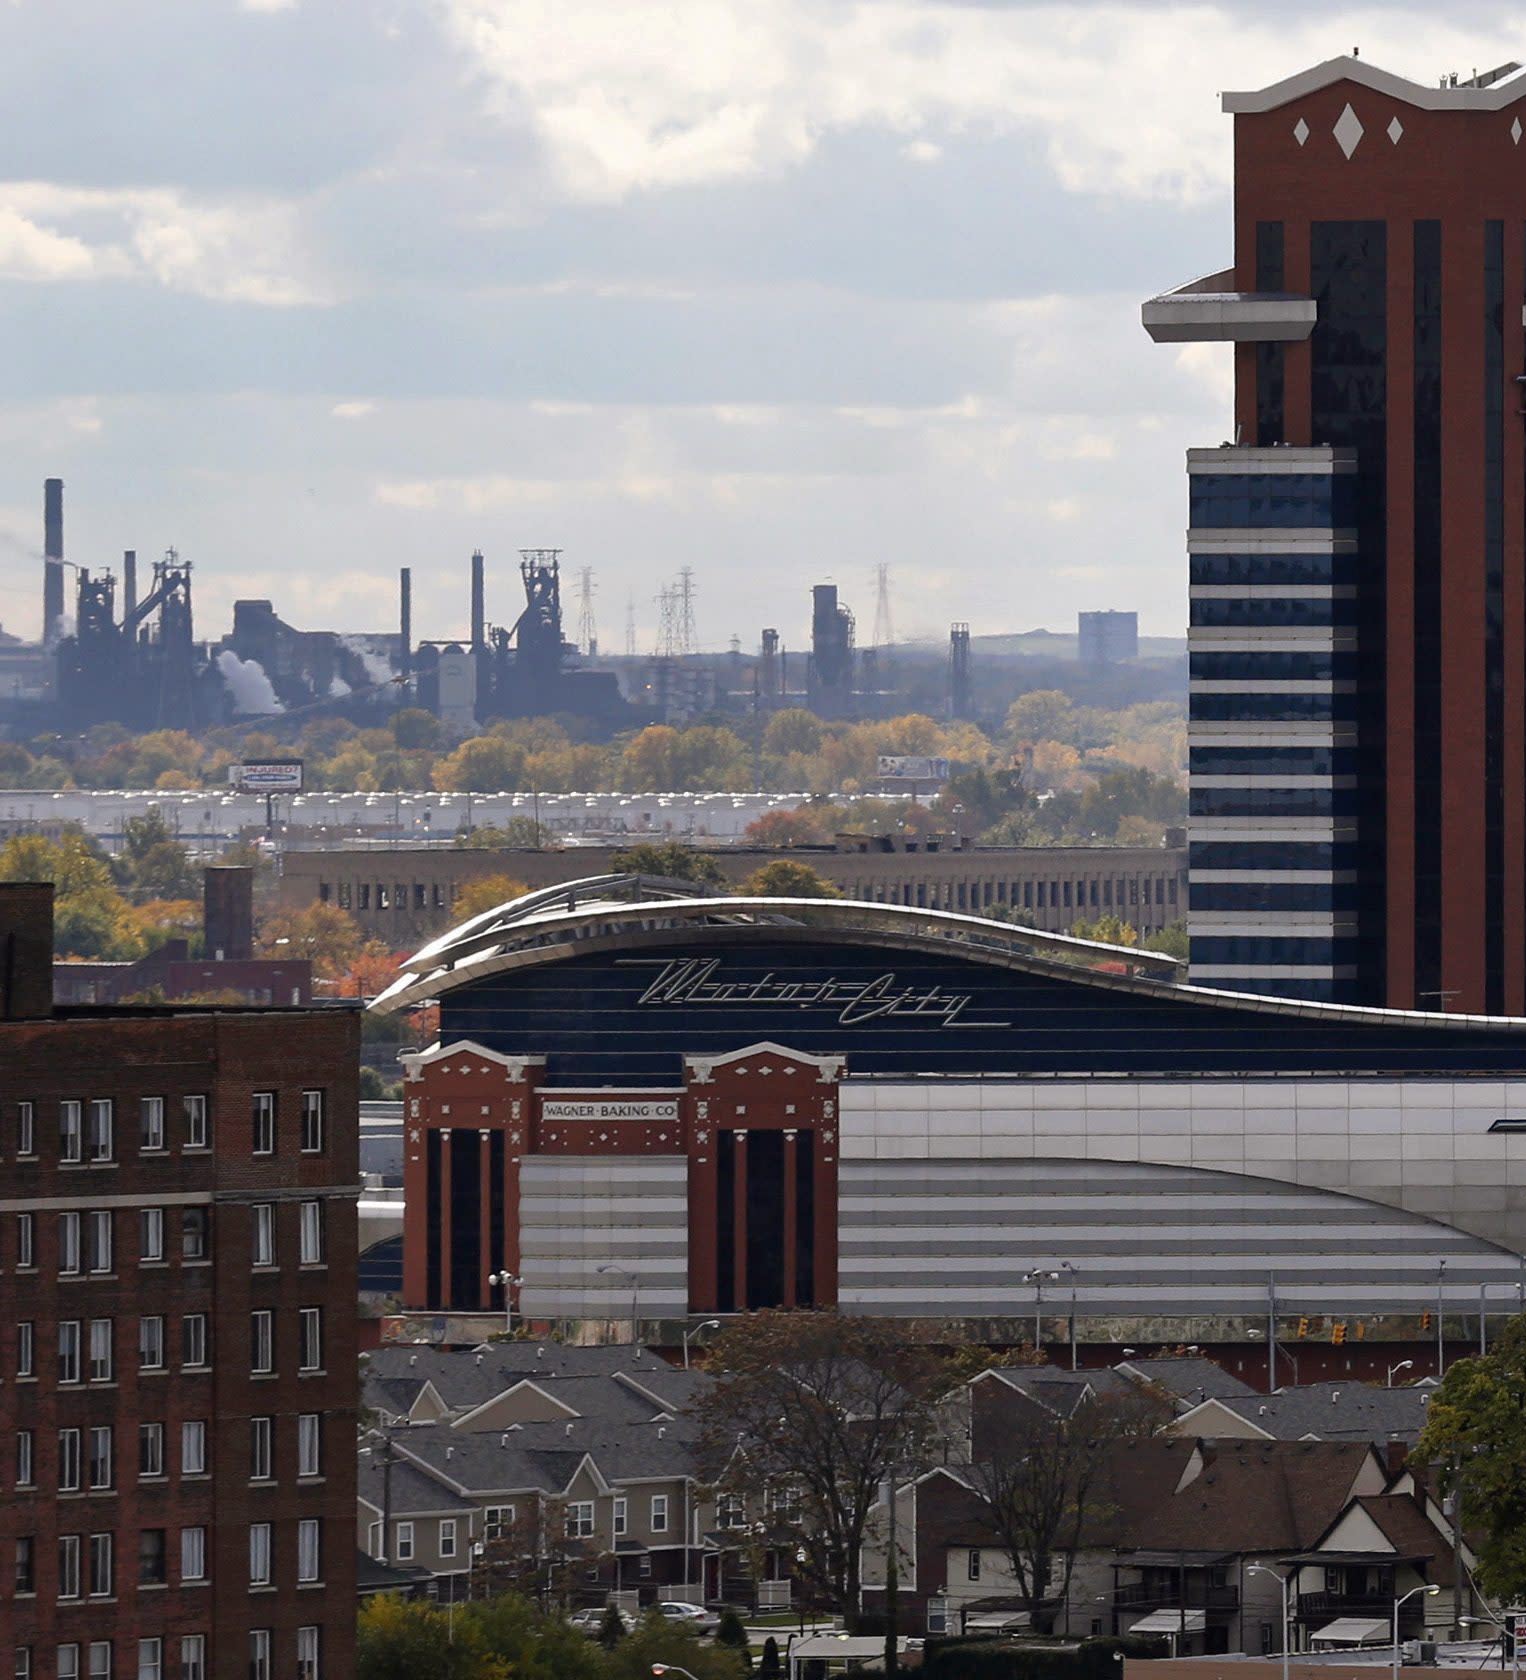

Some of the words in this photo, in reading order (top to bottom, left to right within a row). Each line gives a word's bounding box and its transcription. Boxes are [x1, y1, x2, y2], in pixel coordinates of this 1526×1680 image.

[545, 1104, 594, 1117] WAGNER
[600, 1105, 649, 1117] BAKING
[655, 1105, 675, 1117] CO
